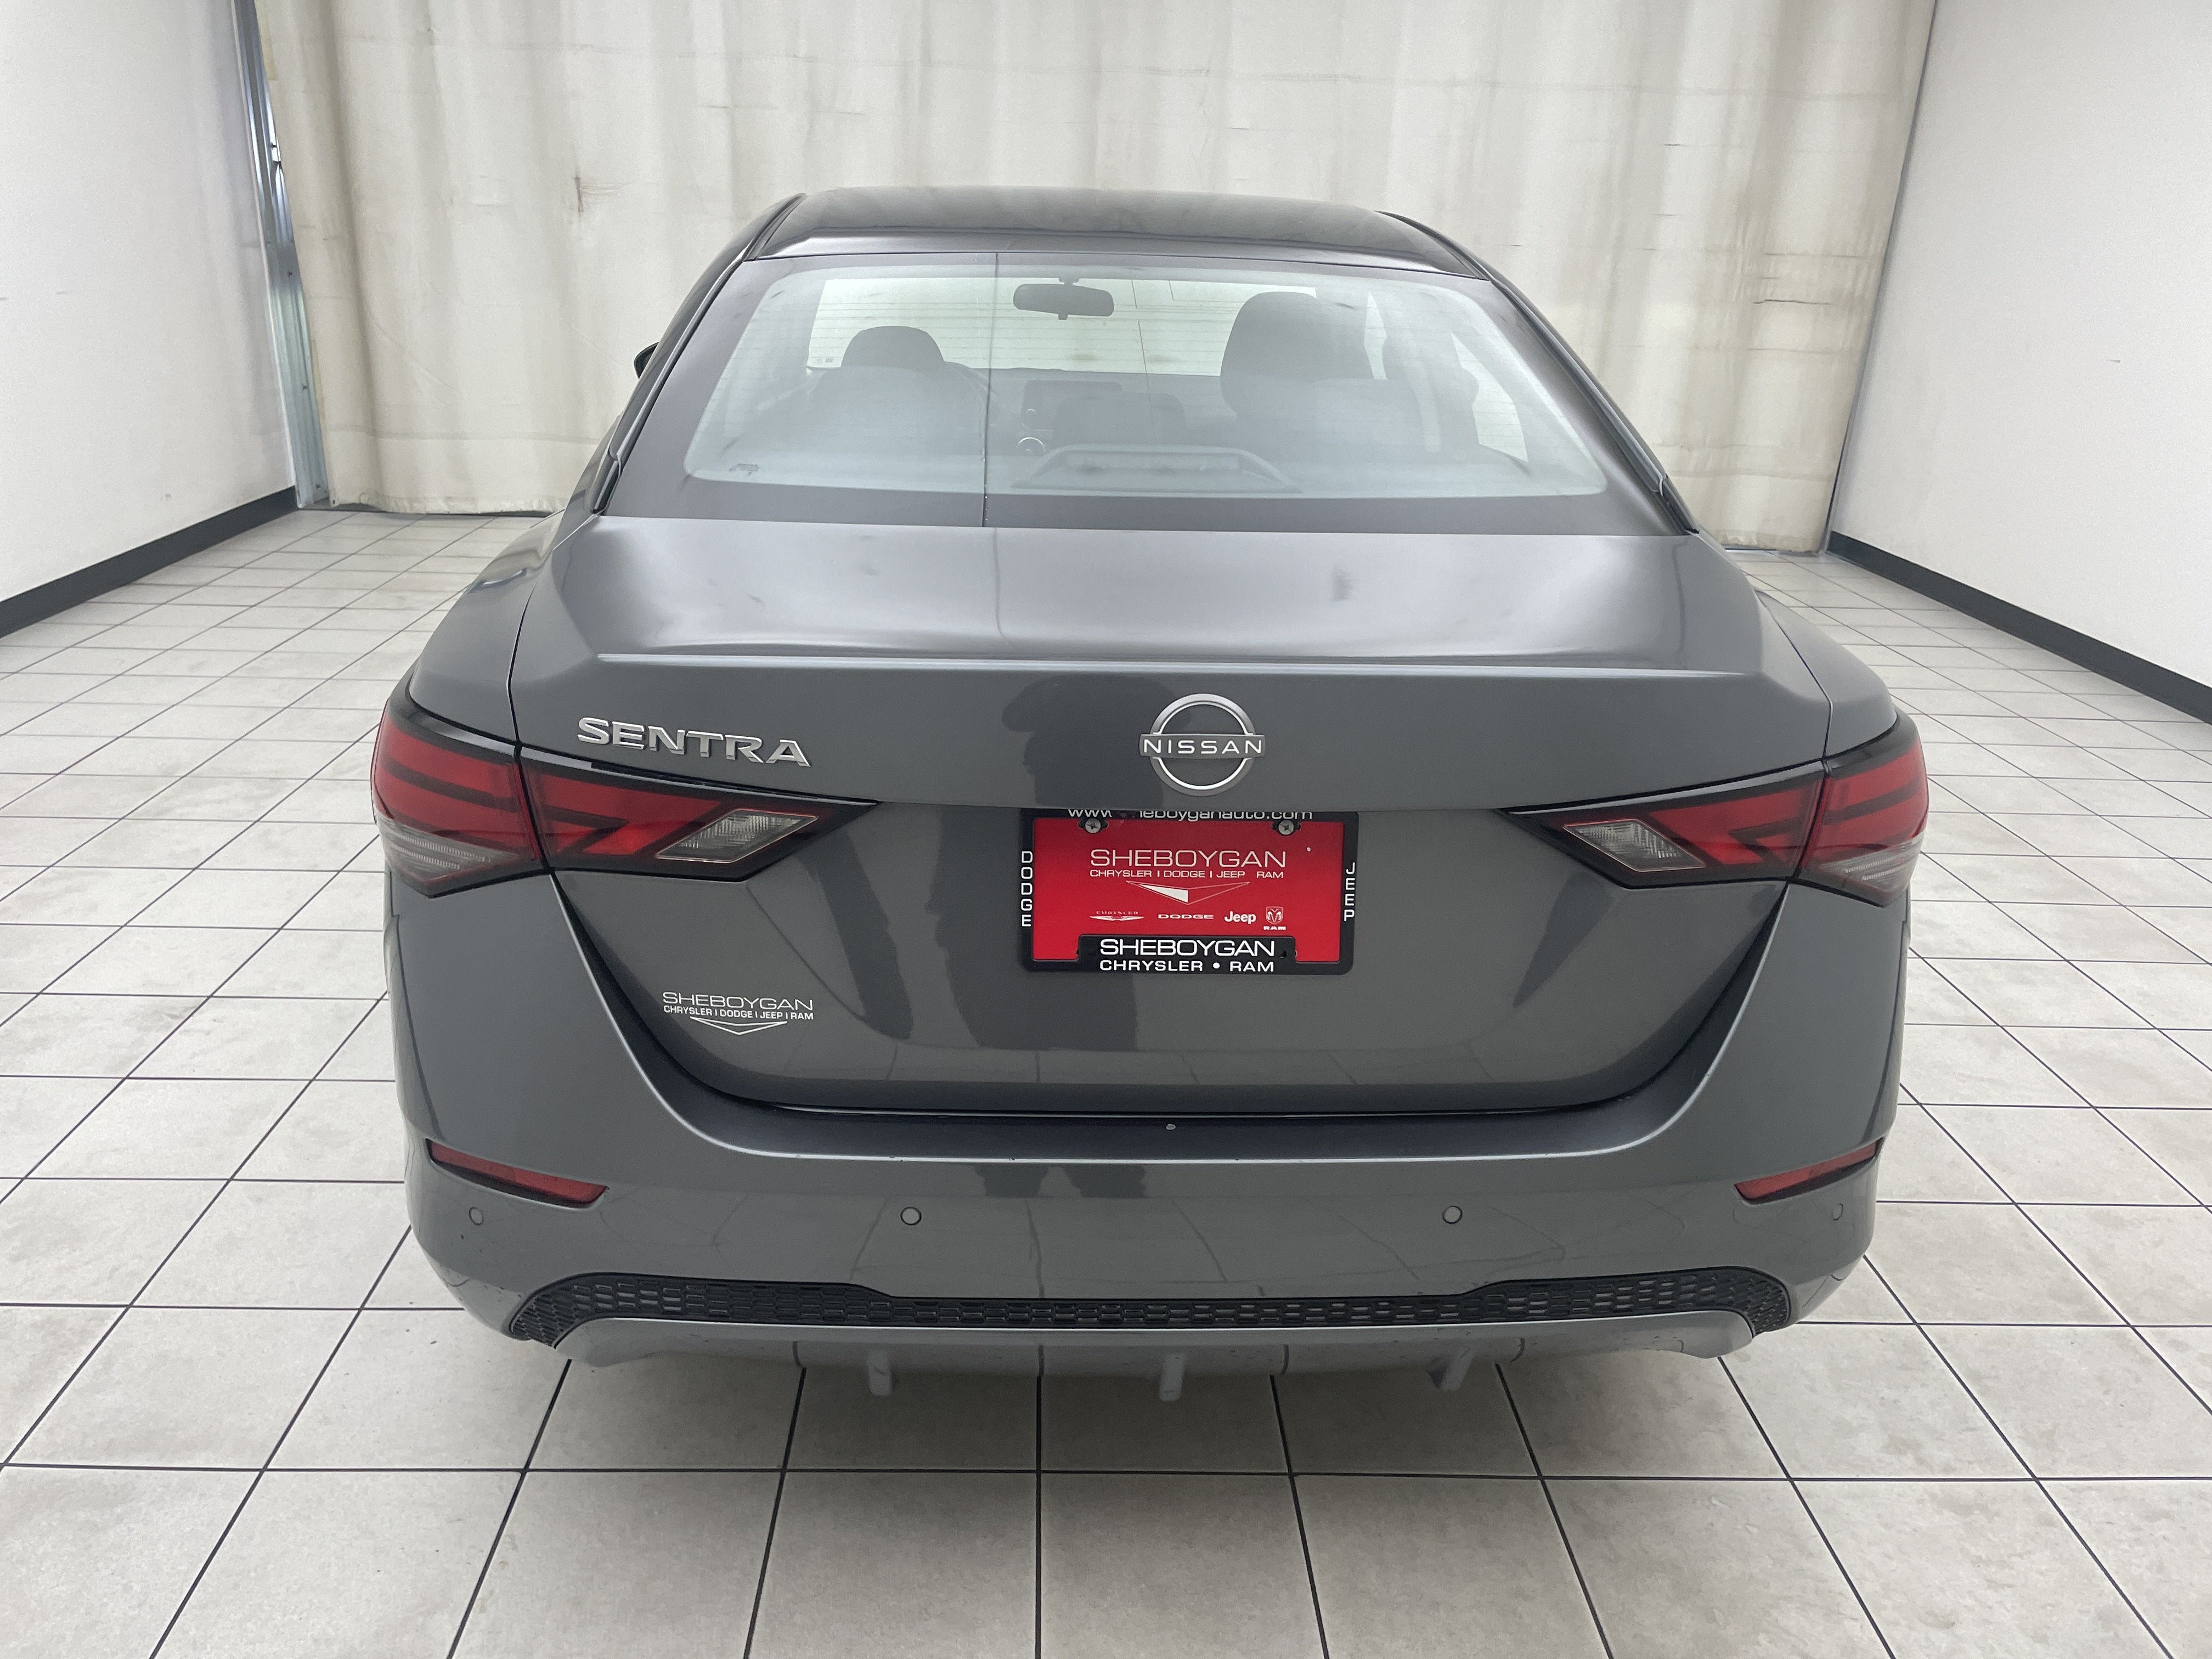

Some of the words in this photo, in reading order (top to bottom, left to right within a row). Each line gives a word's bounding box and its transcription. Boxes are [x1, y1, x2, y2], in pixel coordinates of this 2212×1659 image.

[578, 717, 811, 767] SENTRA
[1143, 739, 1262, 754] NISSAN
[1091, 849, 1286, 868] SHEBOYGAN
[1020, 851, 1033, 927] DODGE
[1344, 862, 1356, 922] JEEP
[1224, 911, 1257, 924] Jeep
[1100, 939, 1274, 957] SHEBOYGAN
[1100, 960, 1203, 972] CHRYSLER
[1229, 961, 1274, 972] RAM
[663, 992, 813, 1011] SHEBOYGAN
[664, 1005, 712, 1016] CHRYSLER
[720, 1009, 753, 1018] DODGE
